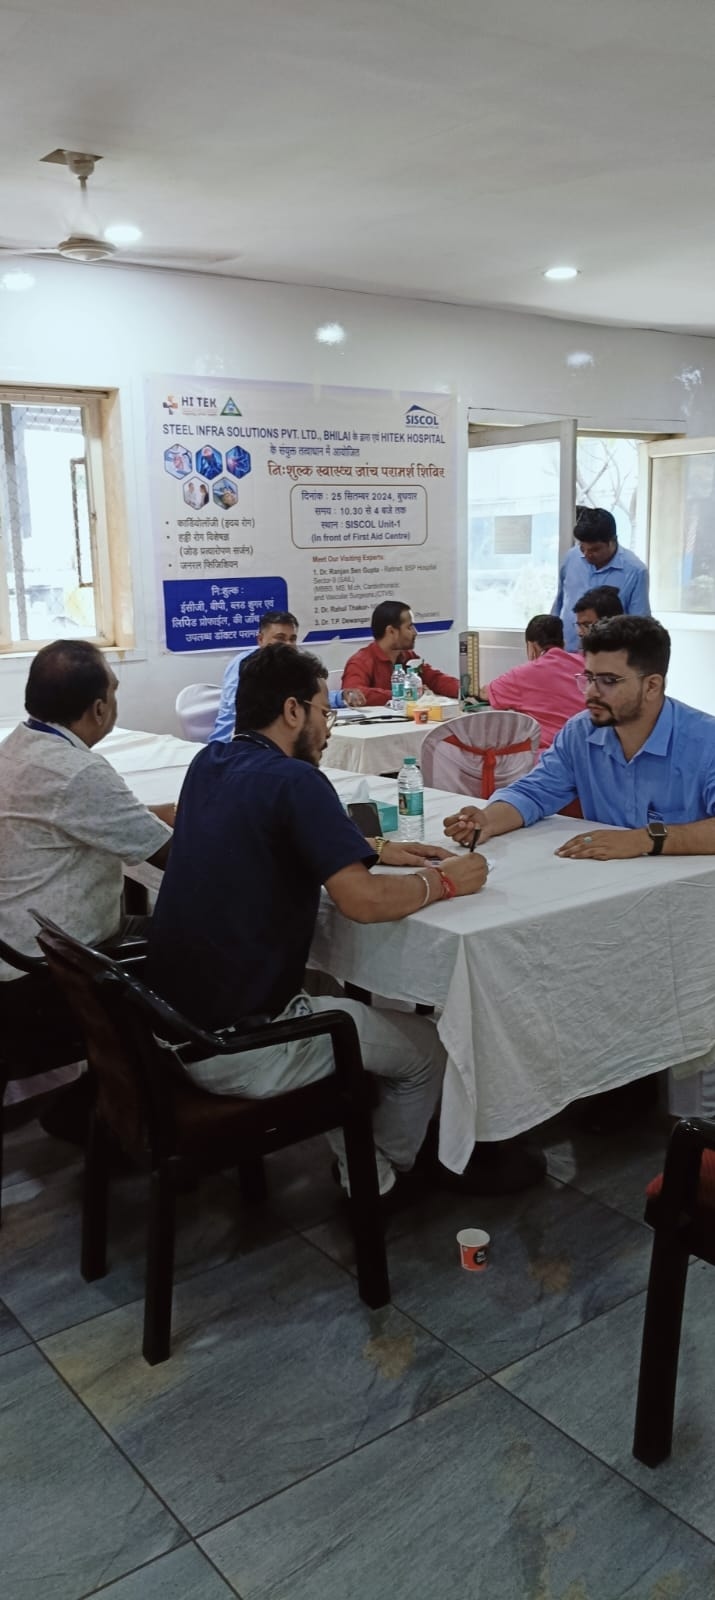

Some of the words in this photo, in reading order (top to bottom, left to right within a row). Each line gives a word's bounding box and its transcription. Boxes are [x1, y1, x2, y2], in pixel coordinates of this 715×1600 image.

[181, 396, 194, 407] HI
[196, 397, 217, 408] TEK
[405, 415, 439, 425] SISCOL
[162, 424, 194, 435] STEEL
[196, 425, 226, 437] INFRA
[227, 427, 279, 439] SOLUTIONS
[281, 428, 300, 439] PVT.
[323, 430, 351, 441] BHILAI
[381, 432, 405, 443] HITEK
[407, 433, 446, 444] HOSPITAL
[270, 442, 277, 454] के
[279, 443, 297, 459] संयुक्त
[333, 445, 360, 456] आयोजित
[316, 465, 353, 477] स्वास्थ्य
[355, 462, 378, 477] जांच
[381, 463, 415, 477] परामर्श
[416, 463, 445, 478] शिविर
[301, 490, 324, 500] दिनांक
[331, 493, 342, 501] 25
[344, 490, 369, 500] सितम्बर
[372, 492, 395, 502] 2024,
[397, 492, 418, 502] बुधवार
[315, 507, 332, 516] समय
[340, 507, 363, 516] 10.30
[365, 505, 372, 515] से
[374, 507, 379, 515] 4
[381, 505, 393, 515] बजे
[395, 506, 407, 515] तक
[241, 516, 255, 529] रोग)
[321, 521, 339, 530] स्थान
[345, 520, 376, 529] SISCOL
[378, 519, 401, 529] Unit-1
[193, 531, 204, 542] रोग
[206, 531, 230, 542] विशेषज्ञ
[323, 533, 341, 542] front
[343, 532, 351, 542] of
[353, 532, 369, 542] First
[371, 531, 383, 541] Aid
[385, 531, 411, 542] Centre)
[340, 554, 361, 563] Visiting
[180, 561, 202, 570] जनरल
[180, 601, 208, 614] ईसीजी,
[209, 599, 228, 612] बीपी,
[264, 597, 275, 609] एवं
[172, 616, 198, 628] लिपिड
[232, 613, 243, 624] की
[185, 632, 212, 642] उपलब्ध
[214, 629, 238, 640] डॉक्टर
